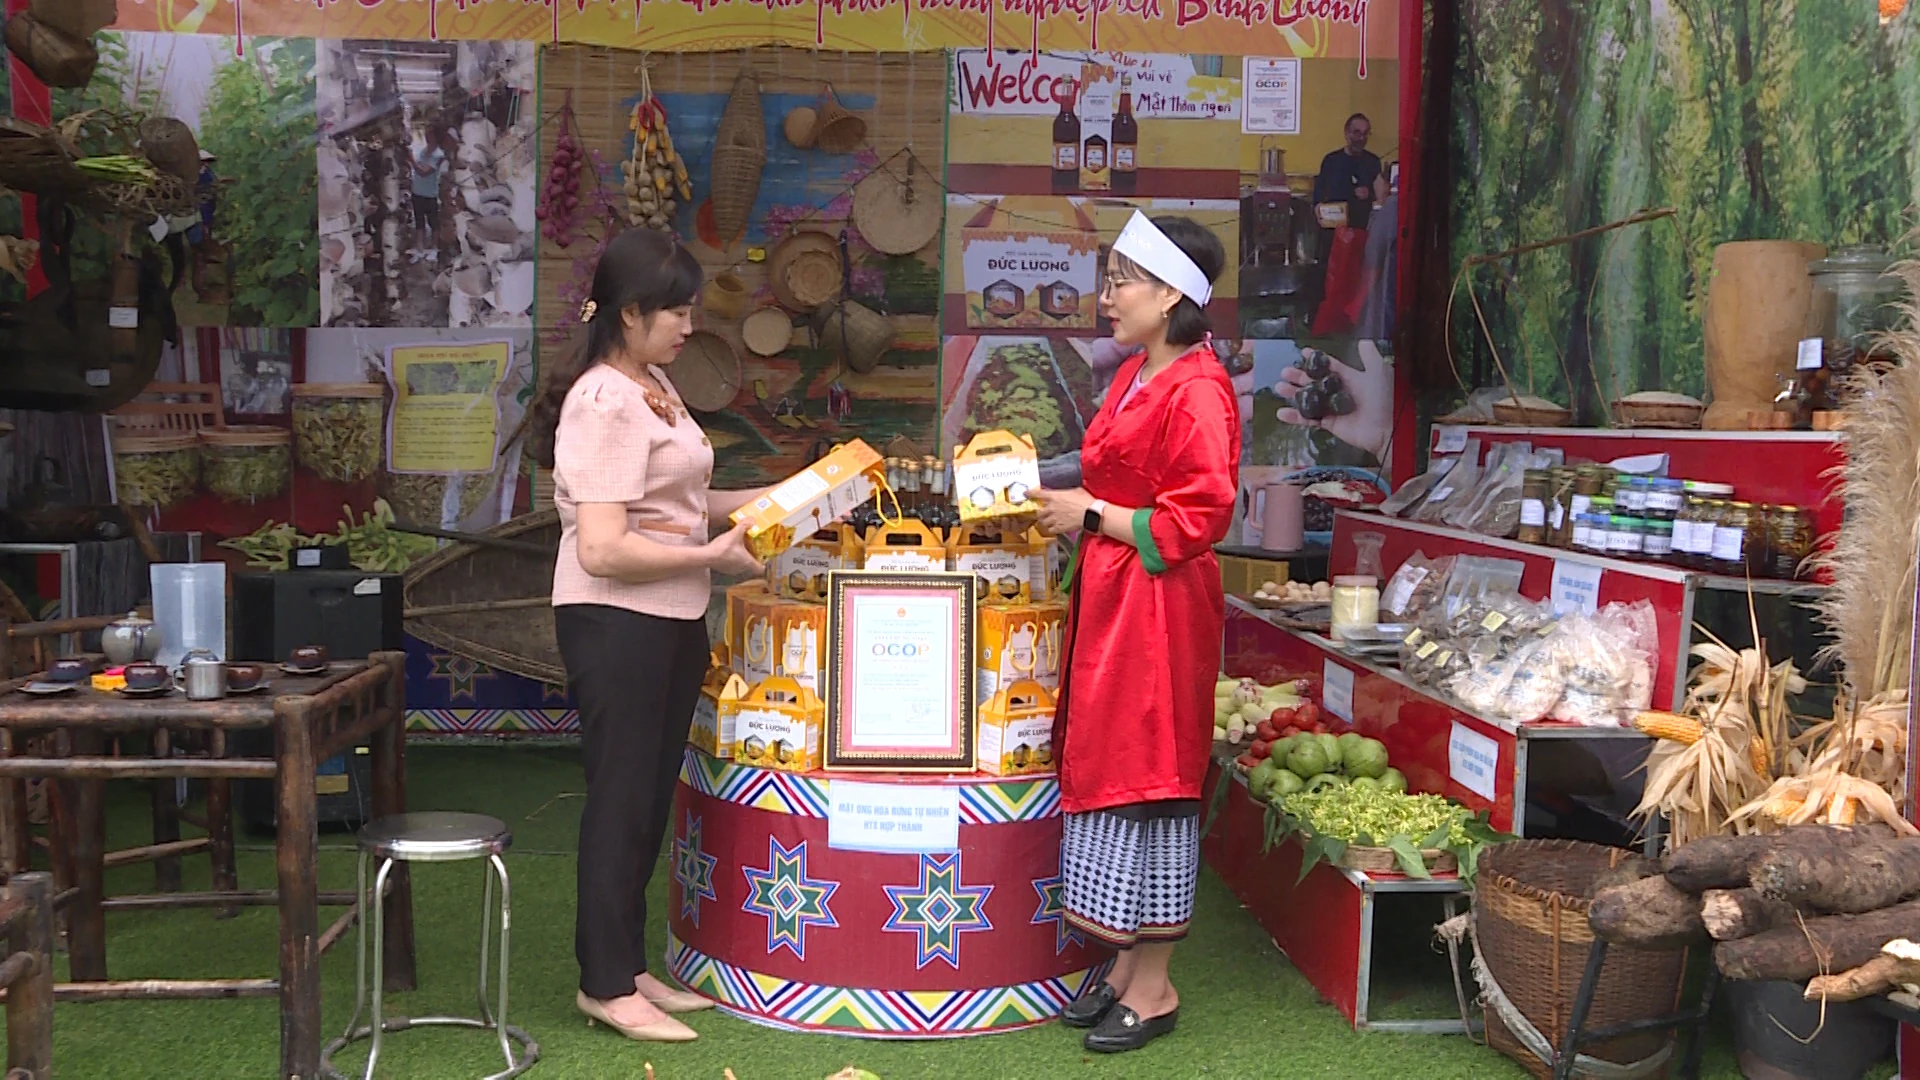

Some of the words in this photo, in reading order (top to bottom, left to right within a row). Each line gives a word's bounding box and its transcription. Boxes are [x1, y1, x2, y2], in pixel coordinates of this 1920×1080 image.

[961, 59, 1082, 109] Welco
[871, 642, 930, 657] OCOP
[856, 804, 872, 815] ONG
[874, 805, 890, 816] HOA
[926, 807, 949, 817] NHIÊN
[897, 819, 924, 832] THÀNH
